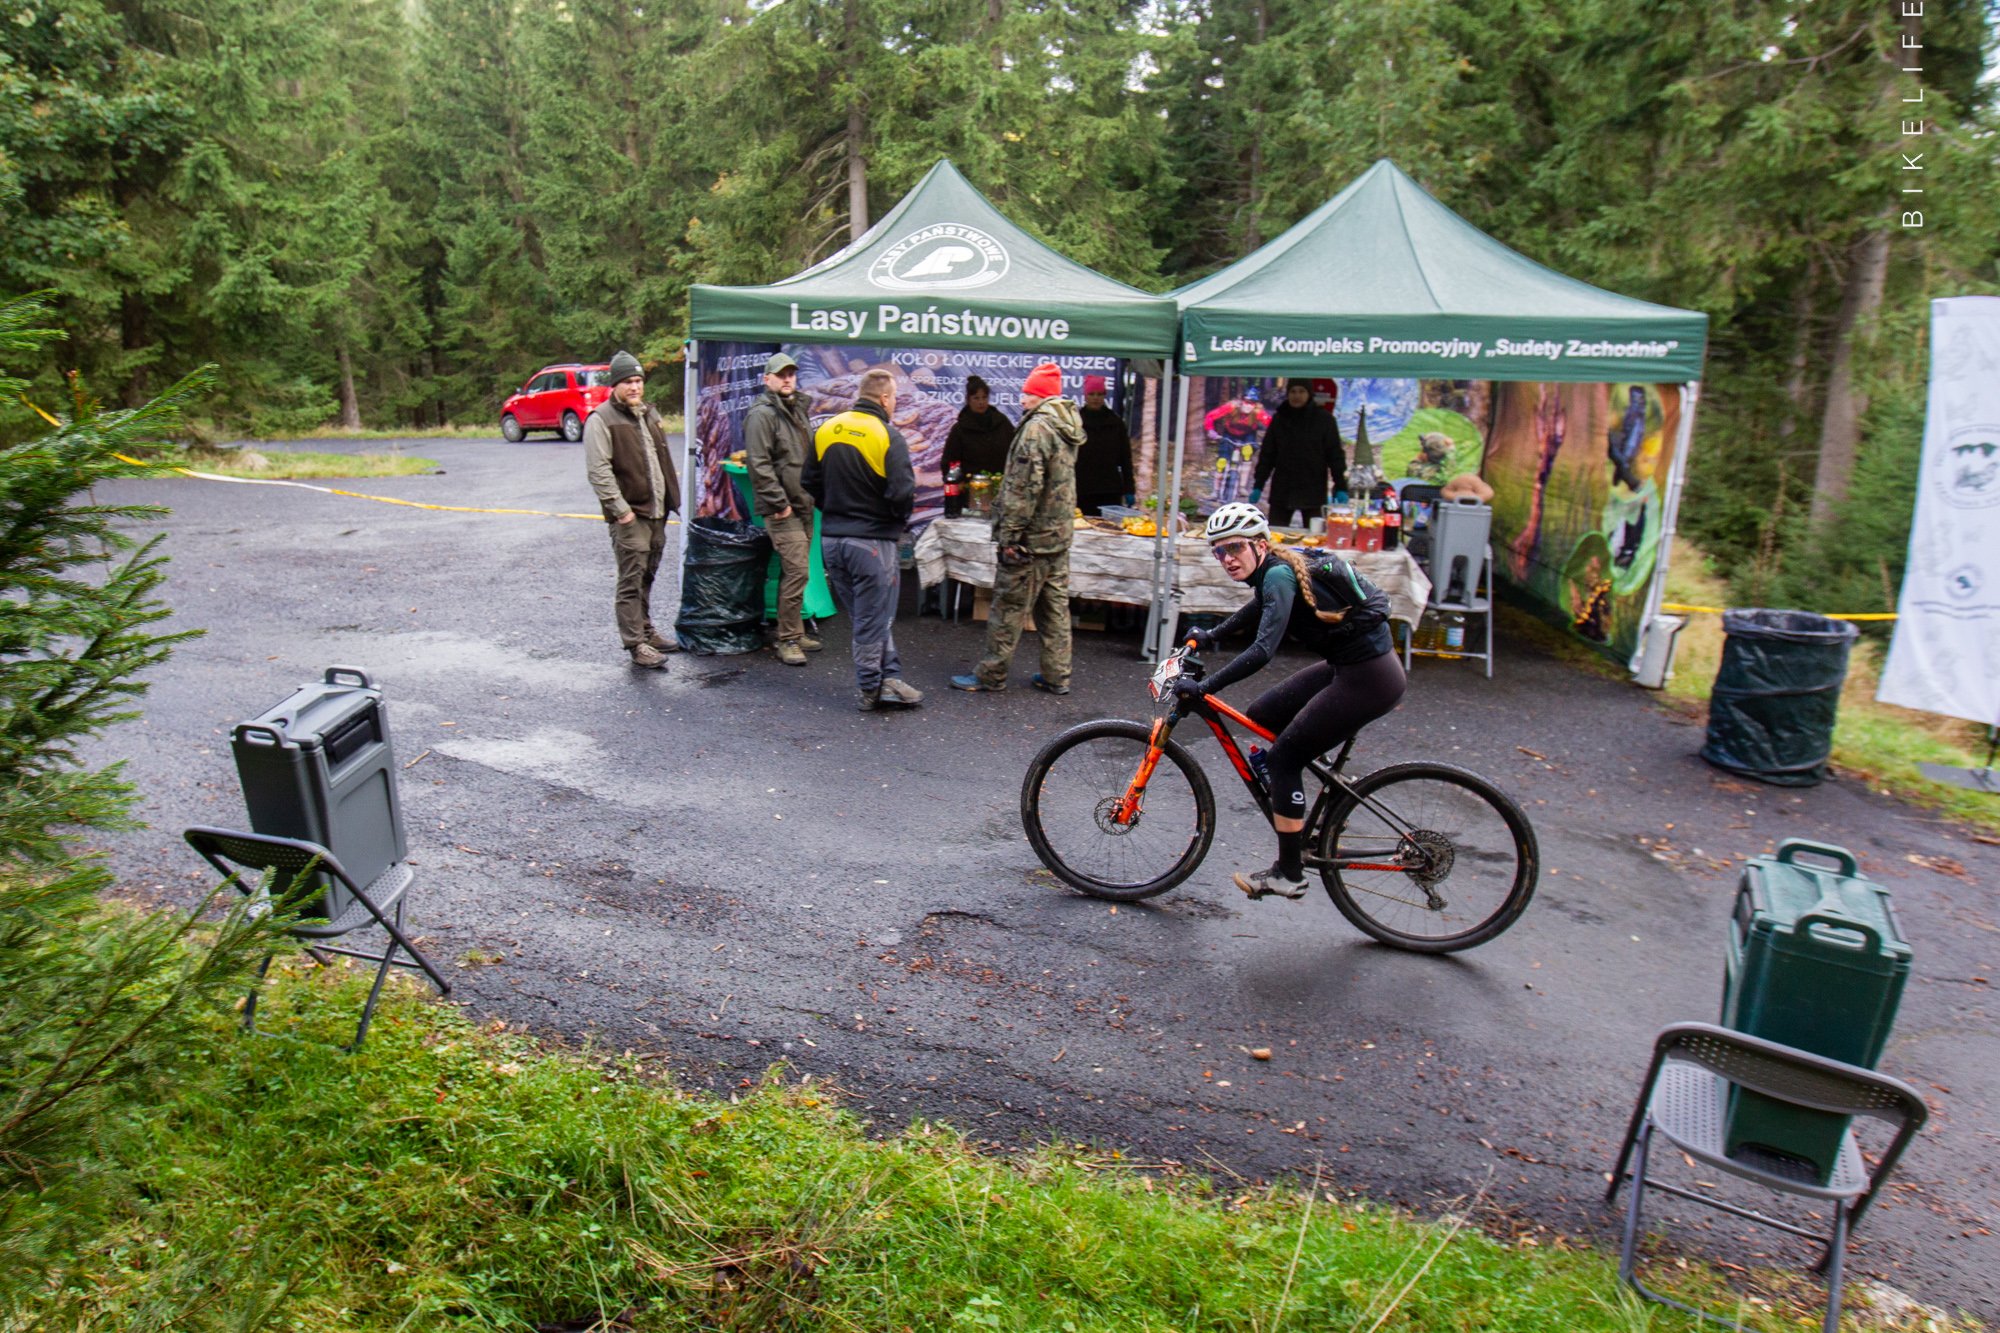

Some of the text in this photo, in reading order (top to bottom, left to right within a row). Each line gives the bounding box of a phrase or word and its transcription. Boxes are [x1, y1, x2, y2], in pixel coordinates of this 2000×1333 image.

[876, 224, 1004, 269] LASY PAŃSTWOWE
[790, 303, 1070, 341] Lasy Państwowe
[1210, 336, 1268, 356] Leśny
[1271, 336, 1364, 356] Kompleks
[1368, 337, 1482, 358] Promocyjny
[1485, 338, 1563, 360] „Sudety
[891, 352, 938, 366] KOŁO
[943, 353, 1033, 369] ŁOWIECKIE
[914, 389, 966, 405] DZIKÓ
